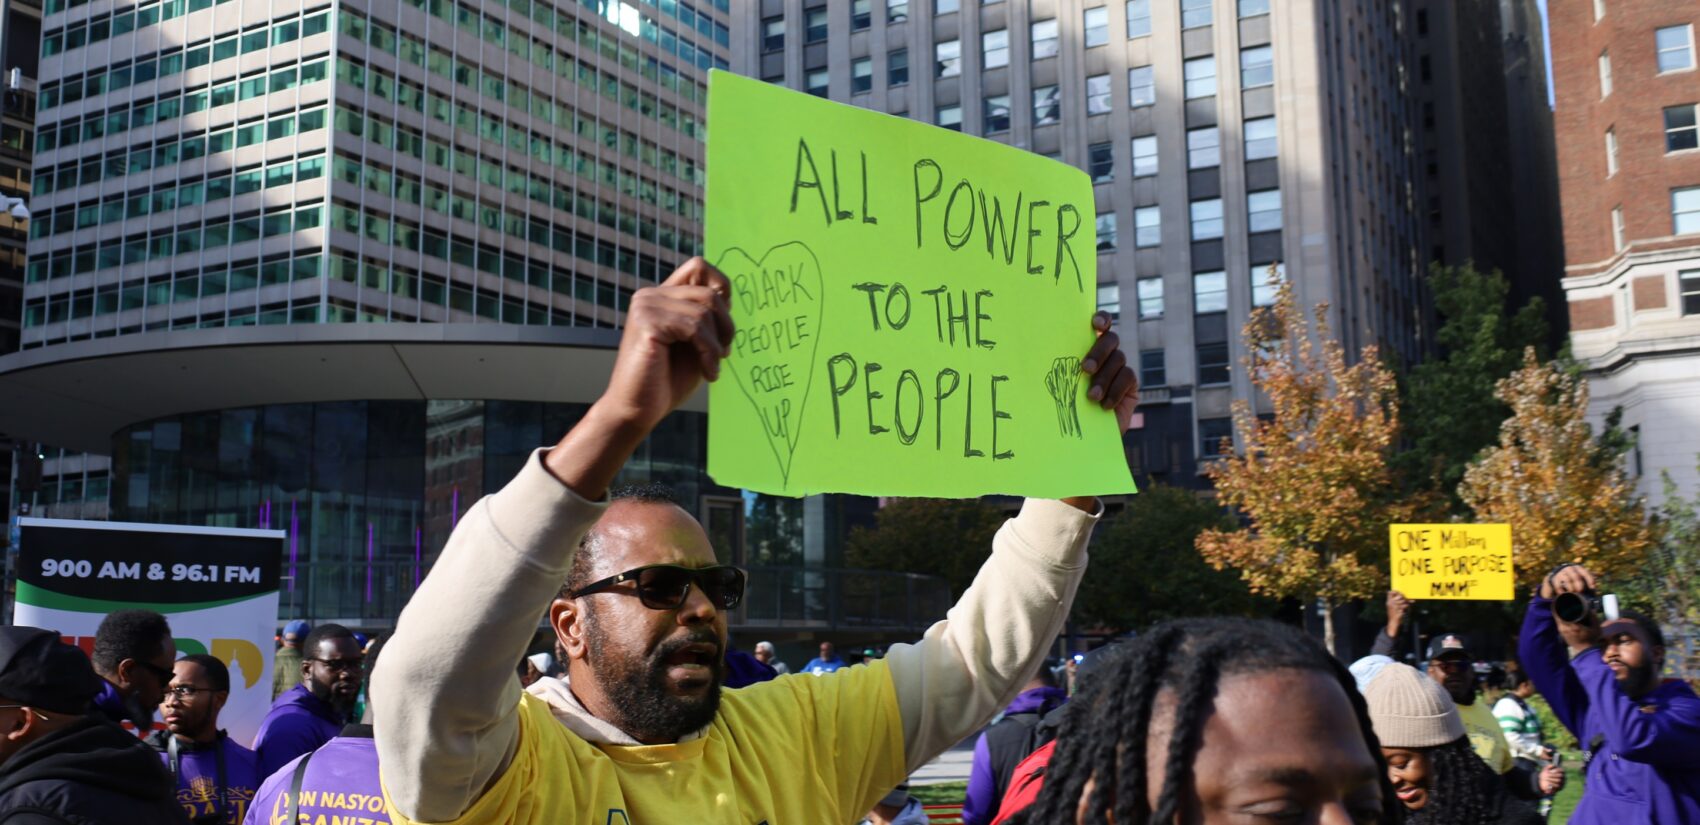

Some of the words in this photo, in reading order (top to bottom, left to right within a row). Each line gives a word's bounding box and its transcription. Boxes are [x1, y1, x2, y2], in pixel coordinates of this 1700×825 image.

[790, 137, 878, 227] ALL
[913, 158, 1083, 293] POWER
[734, 262, 814, 316] BLACK
[735, 315, 810, 358] PEOPLE
[852, 282, 911, 331] TO
[921, 285, 997, 350] THE
[750, 363, 795, 393] RISE
[763, 398, 791, 442] UP
[827, 352, 1015, 461] PEOPLE
[1398, 530, 1431, 552] ONE
[41, 558, 92, 578] 900
[97, 561, 141, 580] AM
[147, 563, 166, 580] &
[171, 563, 218, 582] 96.1
[224, 565, 261, 583] FM
[1398, 558, 1435, 576] ONE
[1443, 554, 1508, 576] PURPOSE
[320, 791, 388, 814] NASYO
